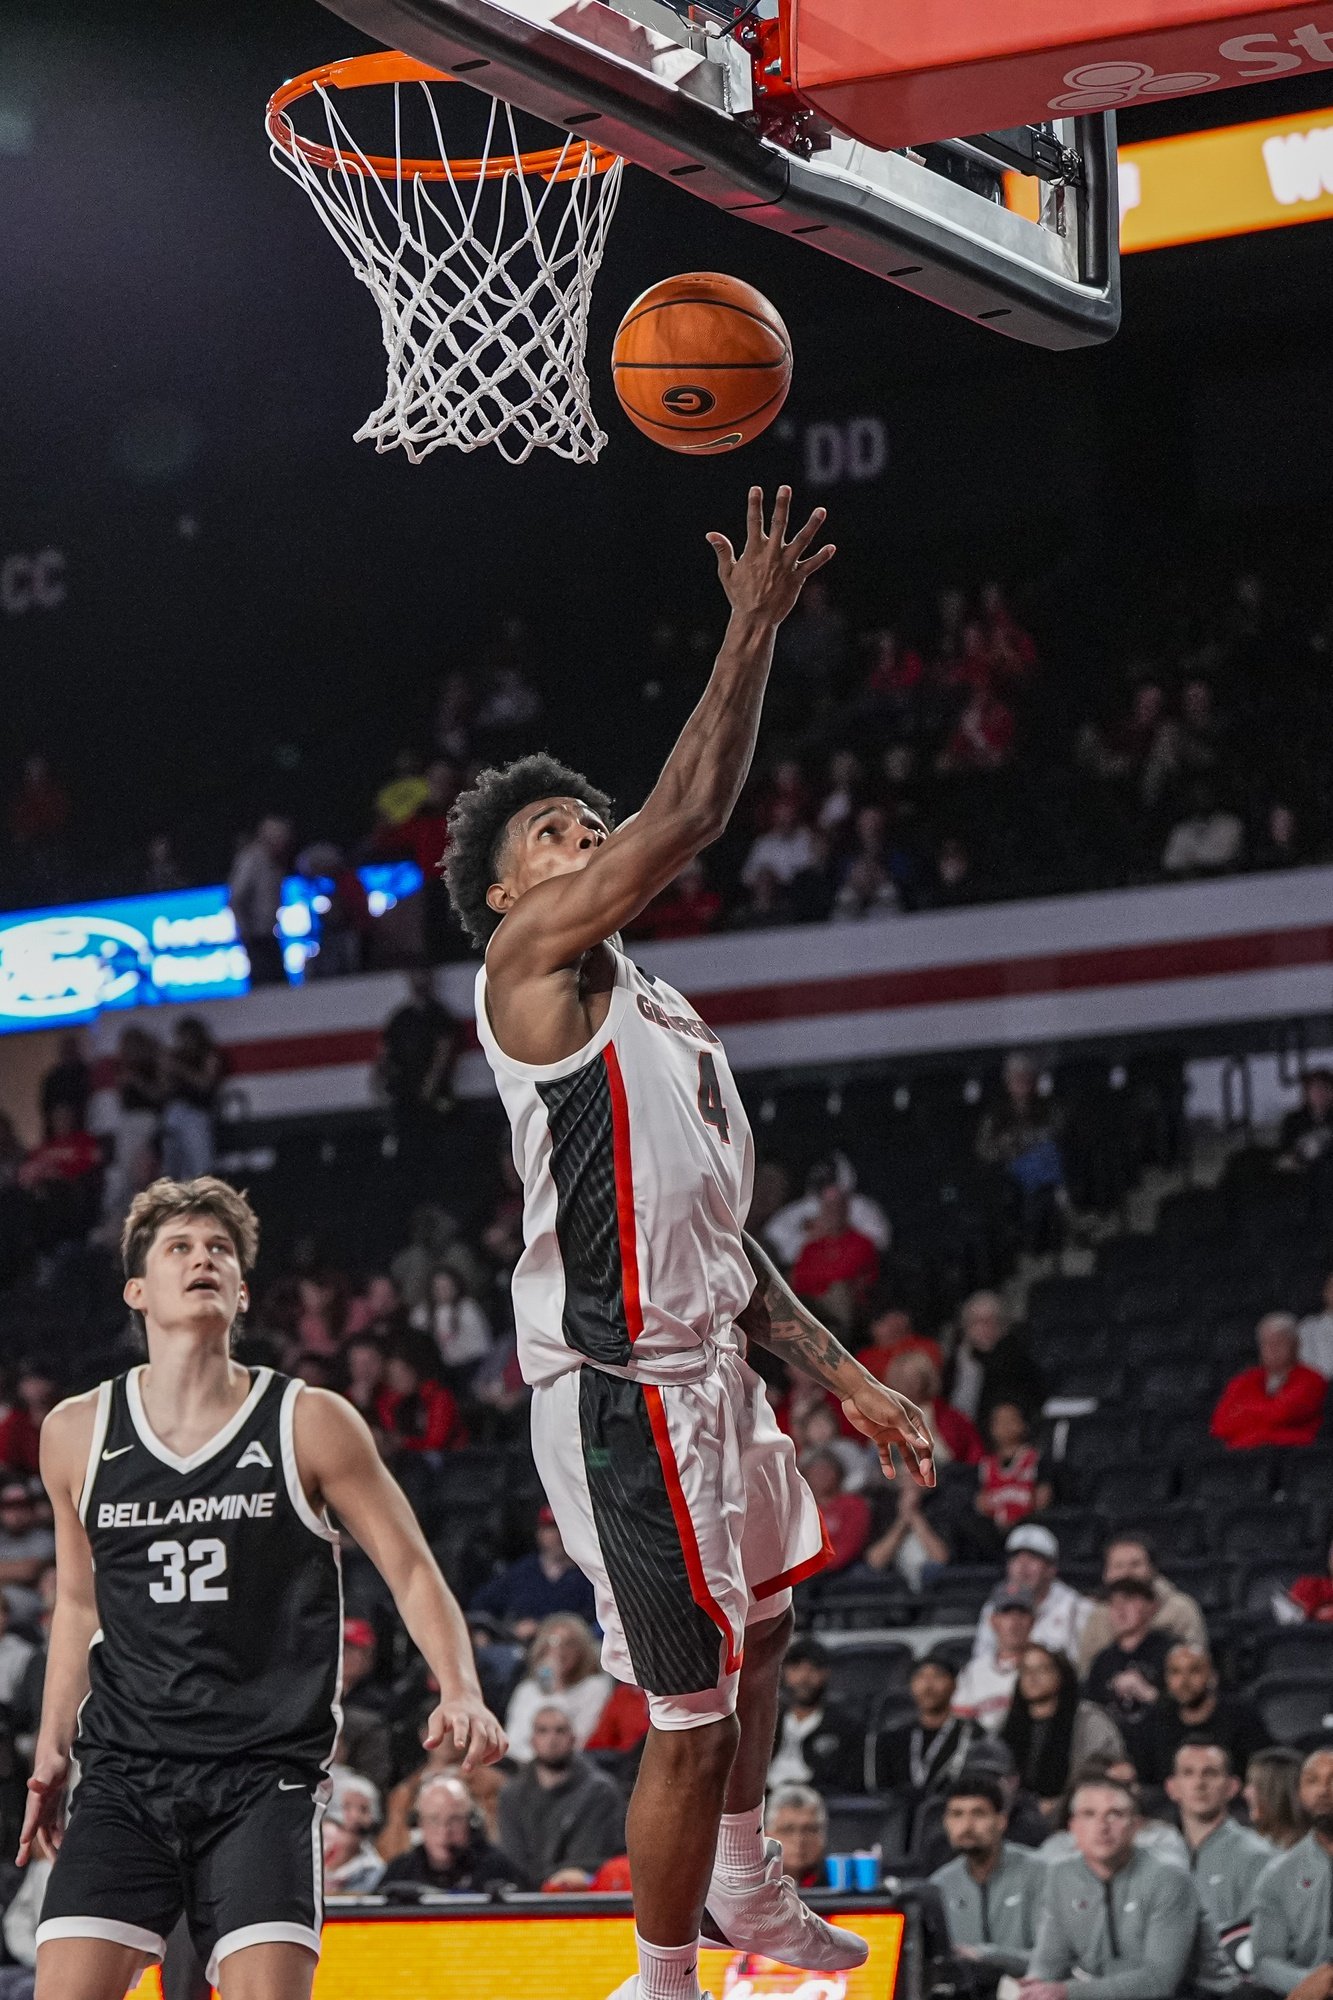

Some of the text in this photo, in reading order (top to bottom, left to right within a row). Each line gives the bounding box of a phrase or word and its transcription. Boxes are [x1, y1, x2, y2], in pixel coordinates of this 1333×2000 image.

[698, 1050, 731, 1144] 4
[97, 1492, 276, 1528] BELLARMINE
[148, 1538, 229, 1603] 32
